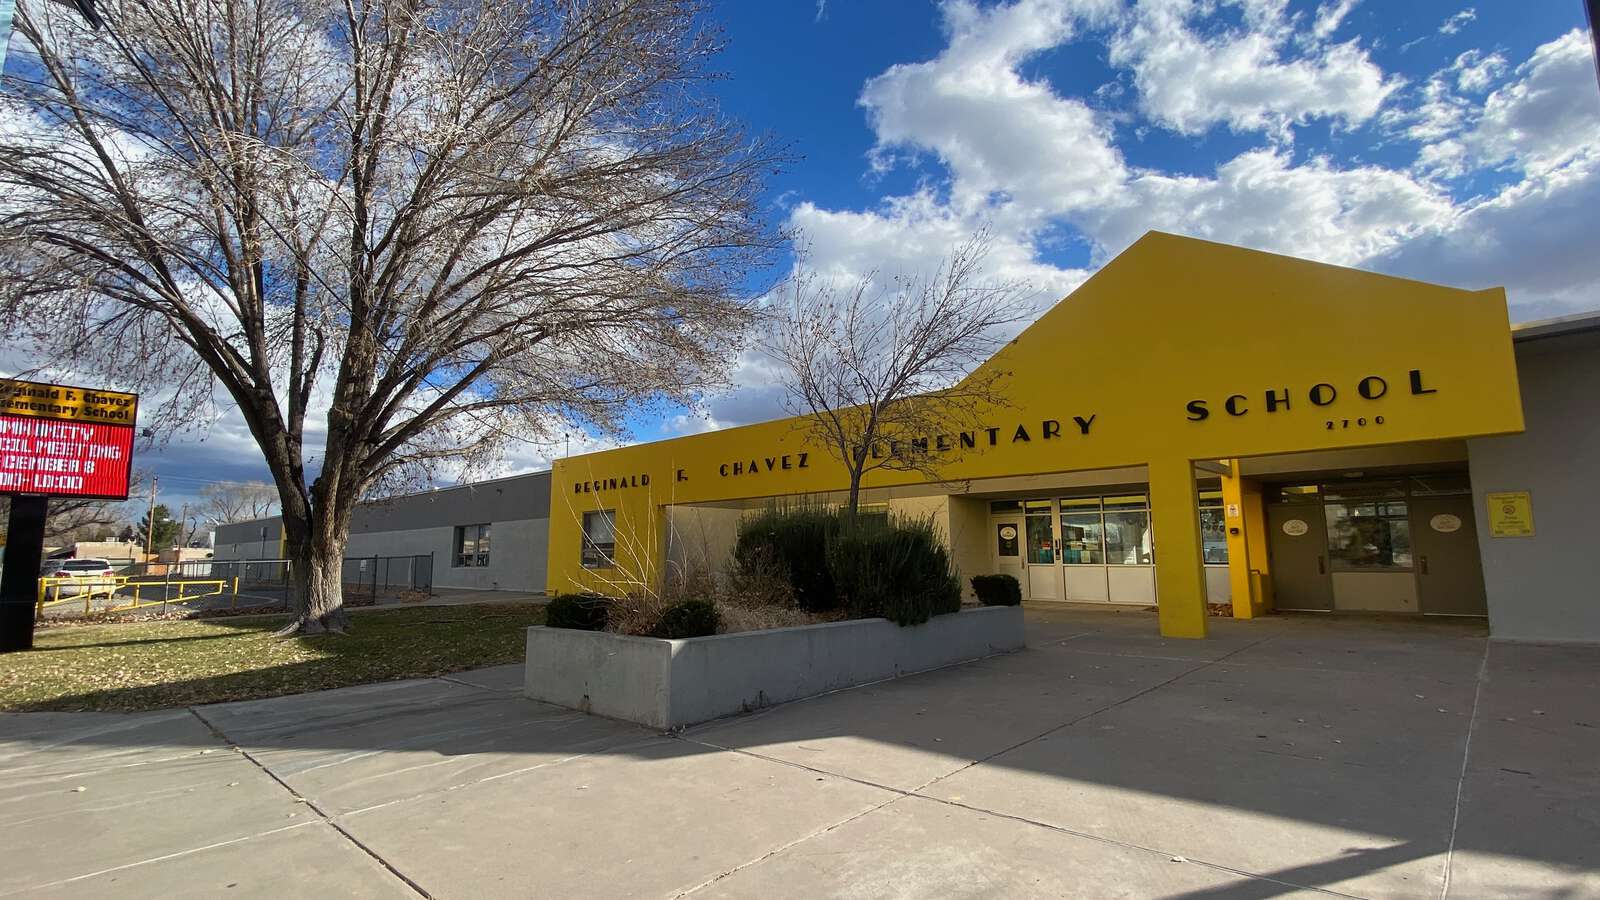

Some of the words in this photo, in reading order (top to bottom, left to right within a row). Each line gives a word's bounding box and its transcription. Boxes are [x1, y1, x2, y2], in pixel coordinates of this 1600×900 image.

[65, 390, 77, 401] F.
[83, 392, 130, 407] Chavez
[84, 406, 129, 420] School
[1326, 415, 1385, 430] 2700
[574, 474, 650, 494] REGINALD
[719, 452, 809, 477] CHAVEZ
[1186, 369, 1437, 421] SCHOOL
